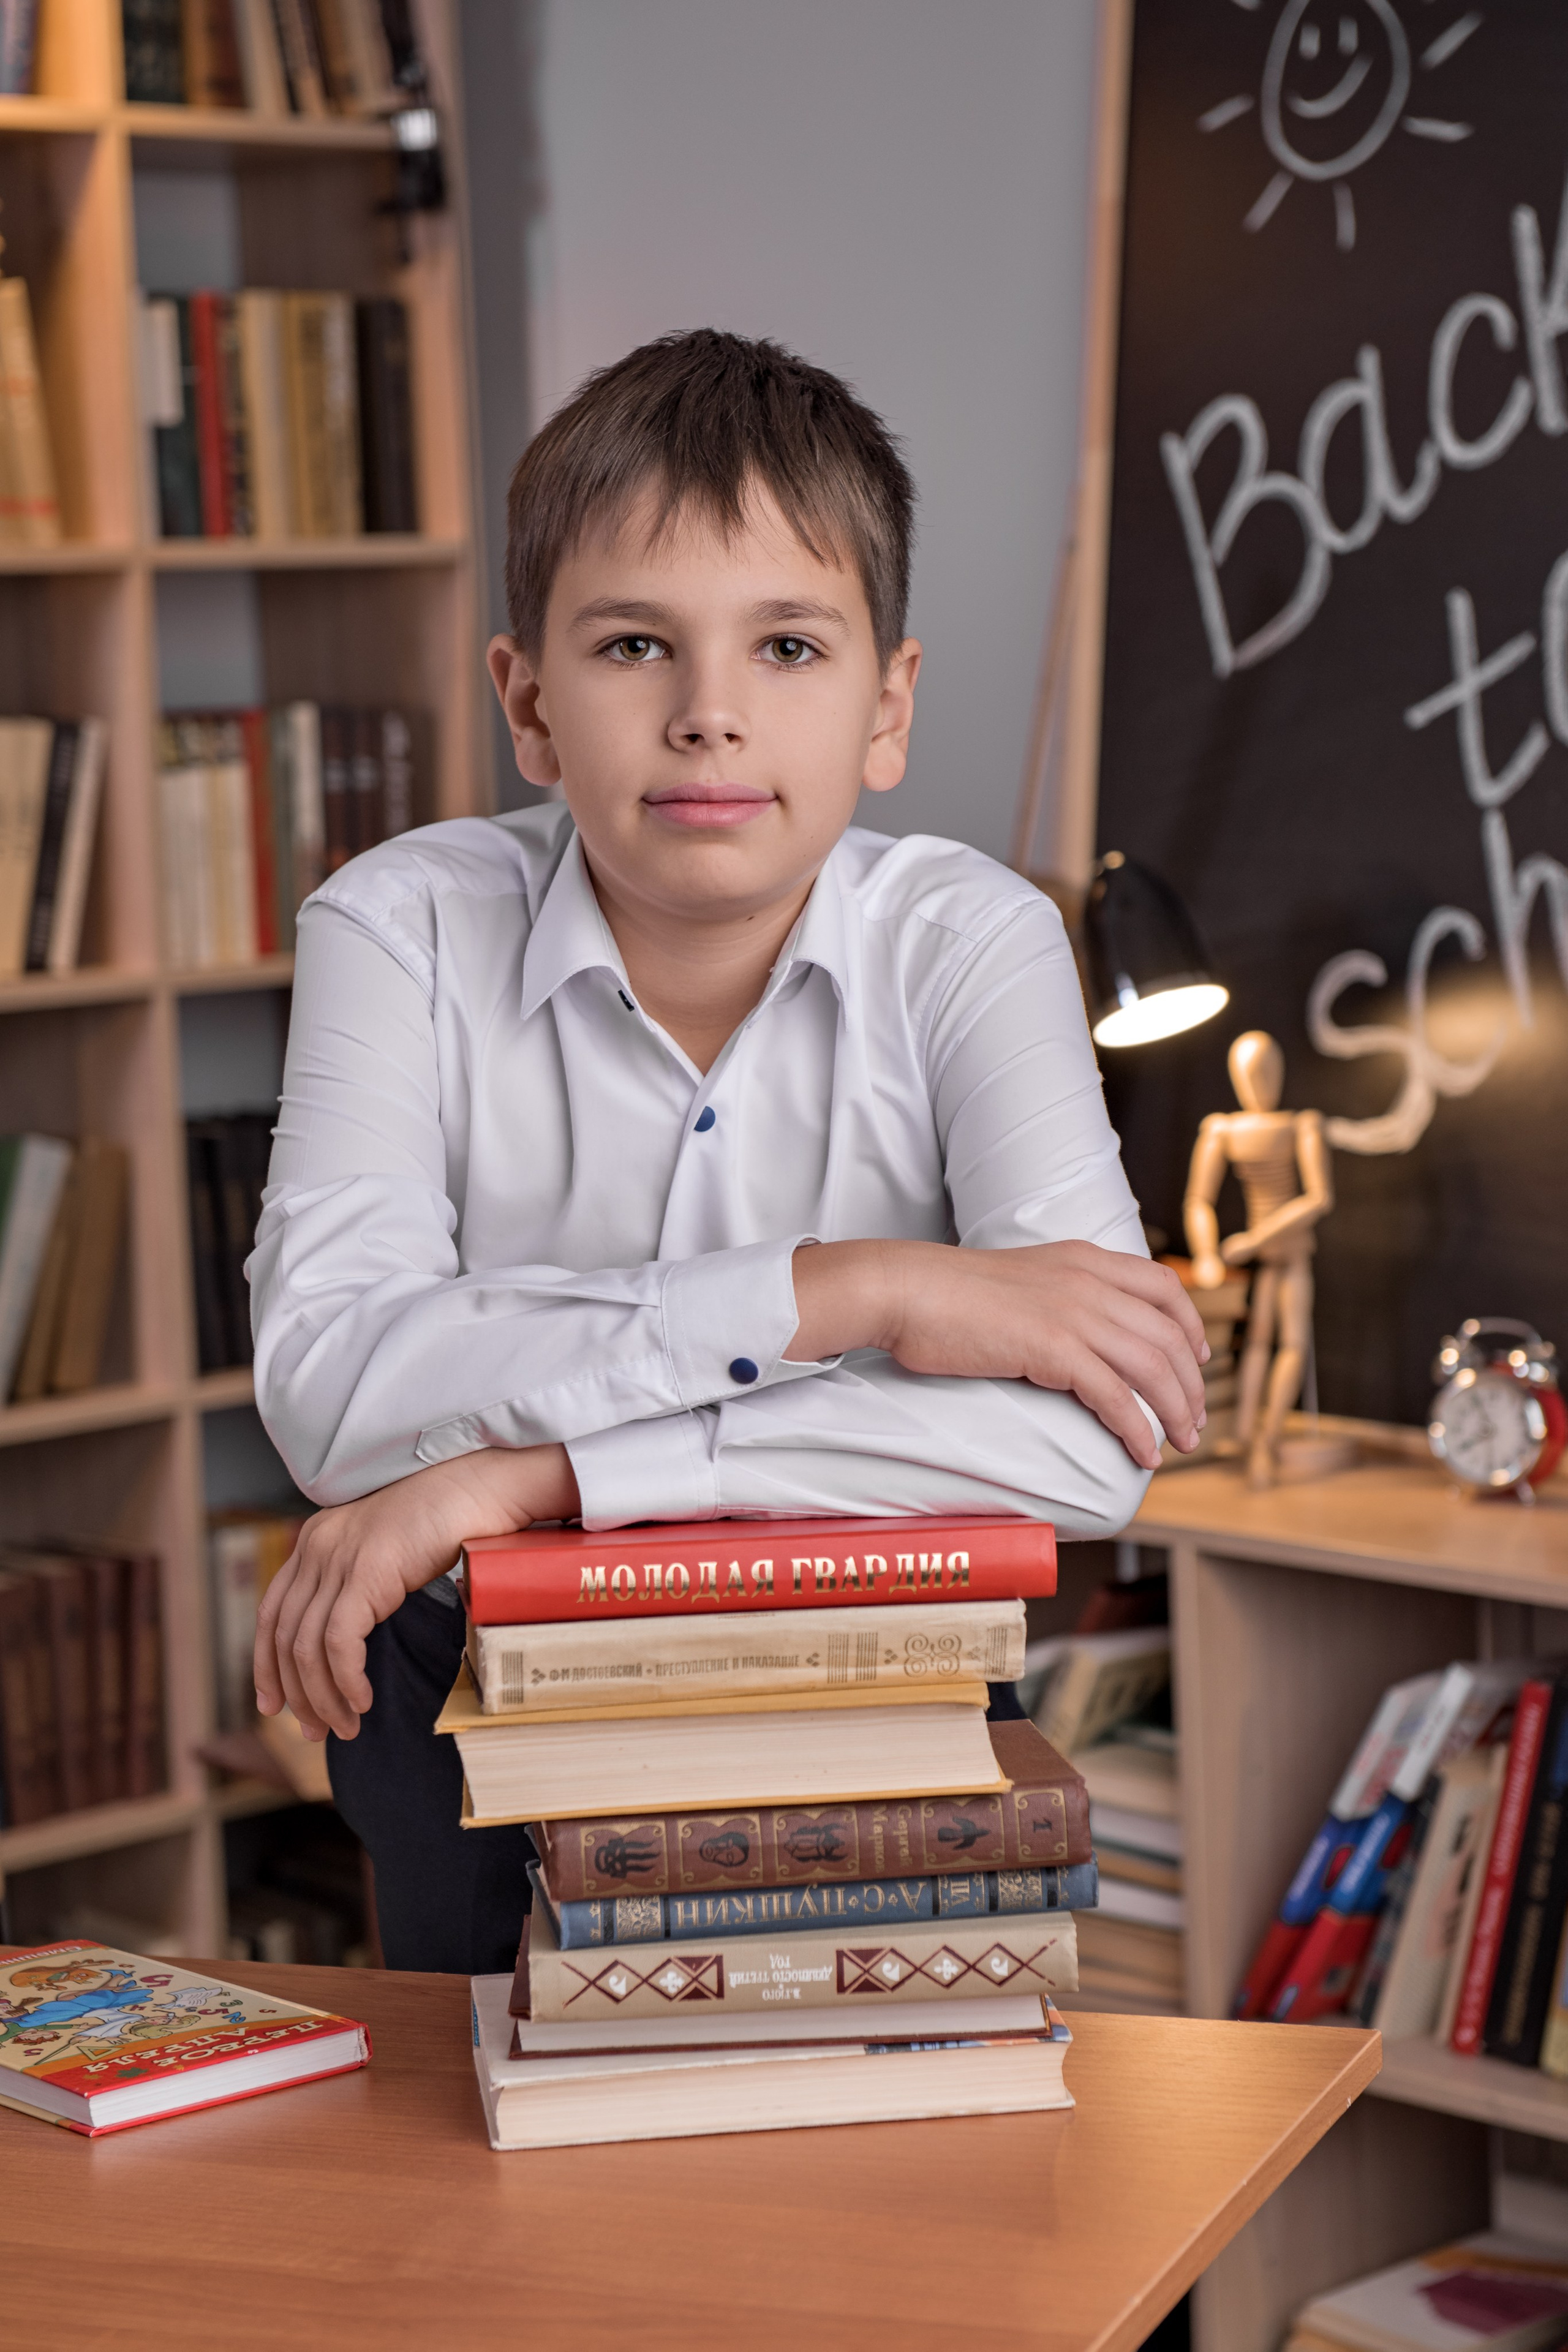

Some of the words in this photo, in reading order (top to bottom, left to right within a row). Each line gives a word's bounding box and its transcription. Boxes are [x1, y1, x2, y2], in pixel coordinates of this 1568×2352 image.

[576, 1559, 774, 1604] МОЛОДАЯ
[791, 1551, 970, 1595] ГВАРДИЯ
[655, 1658, 728, 1676] ПРЕСТУПЛЕНИЕ
[733, 1657, 739, 1670] И
[742, 1655, 799, 1669] НАКАЗАНИЕ
[1033, 1818, 1052, 1834] 1
[674, 1883, 847, 1929] ПУШКИН
[769, 1954, 791, 1970] ГОД
[140, 1974, 174, 1988] 5
[728, 1970, 769, 1988] ТРЕТИЙ
[772, 1966, 833, 1983] ДЕВЯНОСТО
[83, 2026, 250, 2073] АПРЕЛЯ
[153, 2020, 323, 2067] ПЕРВОЕ
